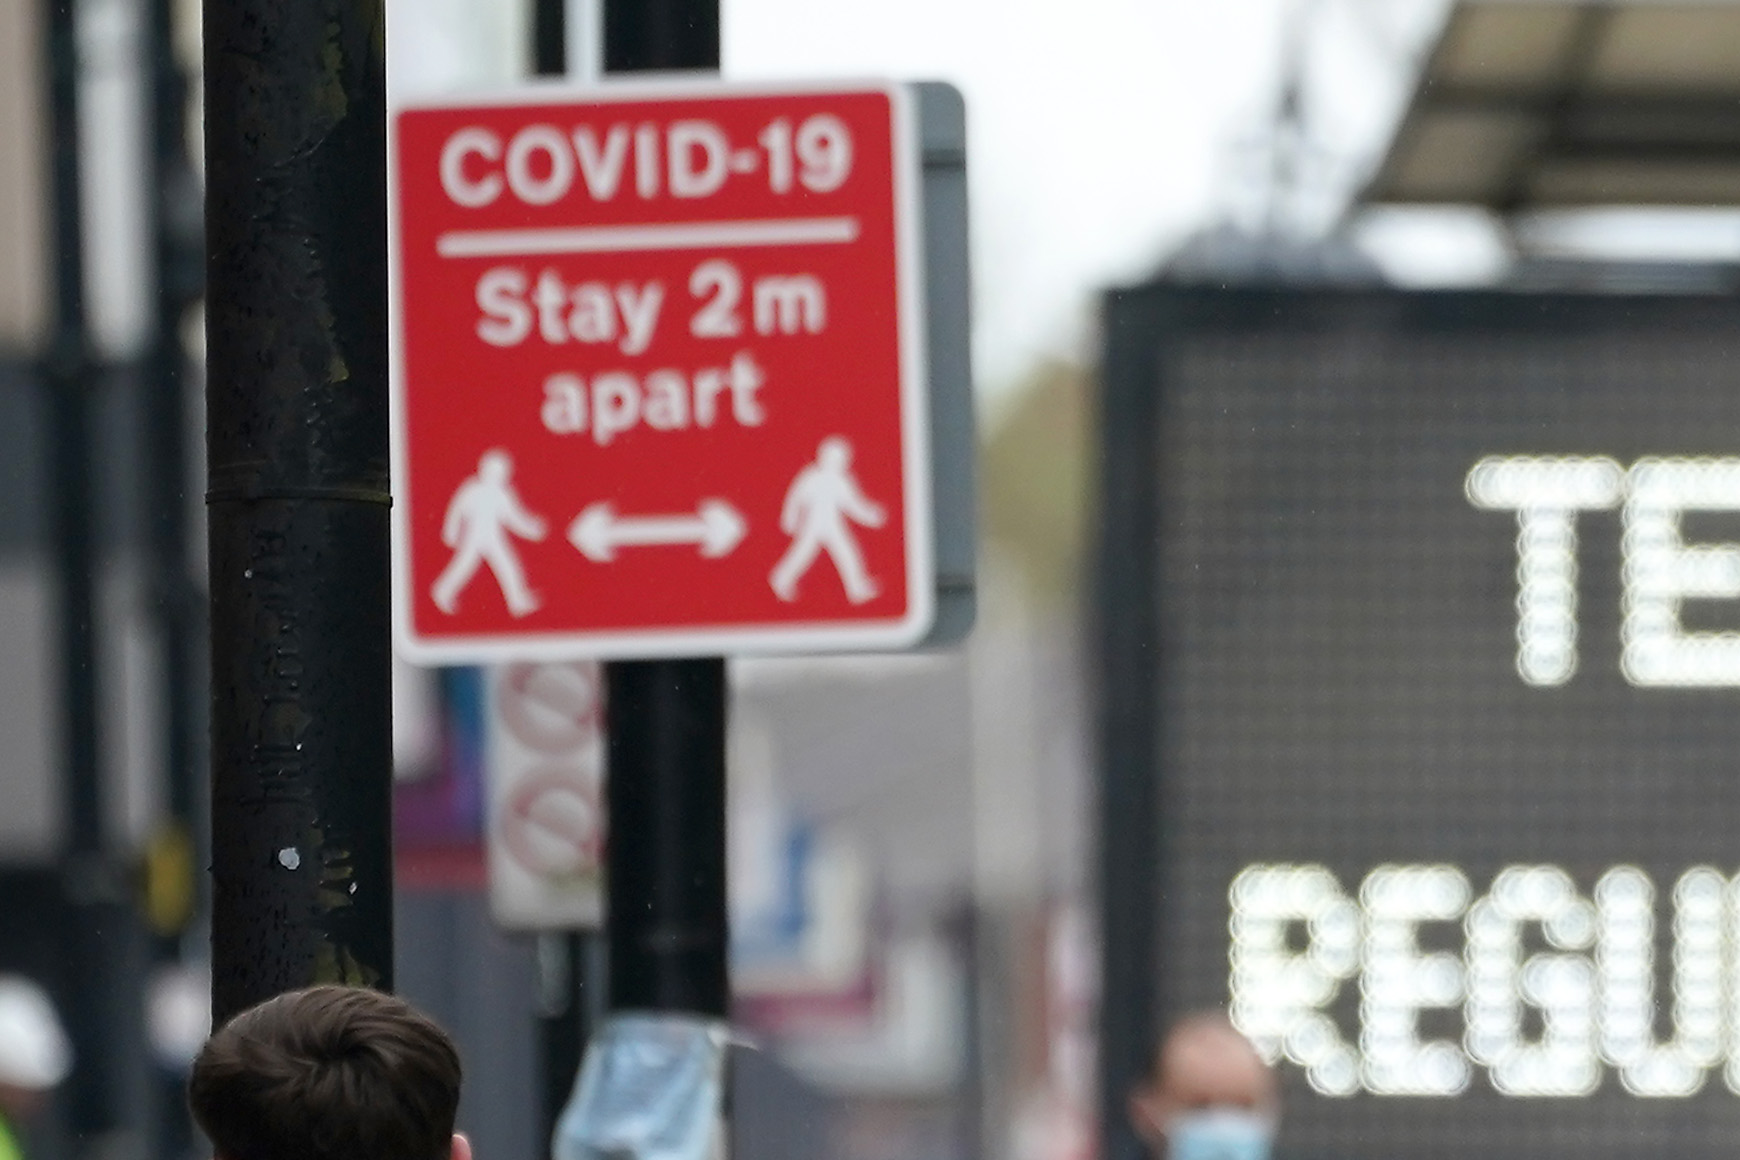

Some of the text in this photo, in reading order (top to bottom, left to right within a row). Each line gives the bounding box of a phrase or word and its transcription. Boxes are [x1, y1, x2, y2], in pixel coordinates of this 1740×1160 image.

[440, 115, 852, 207] COVID-19
[476, 267, 663, 356] Stay
[541, 352, 765, 445] apart
